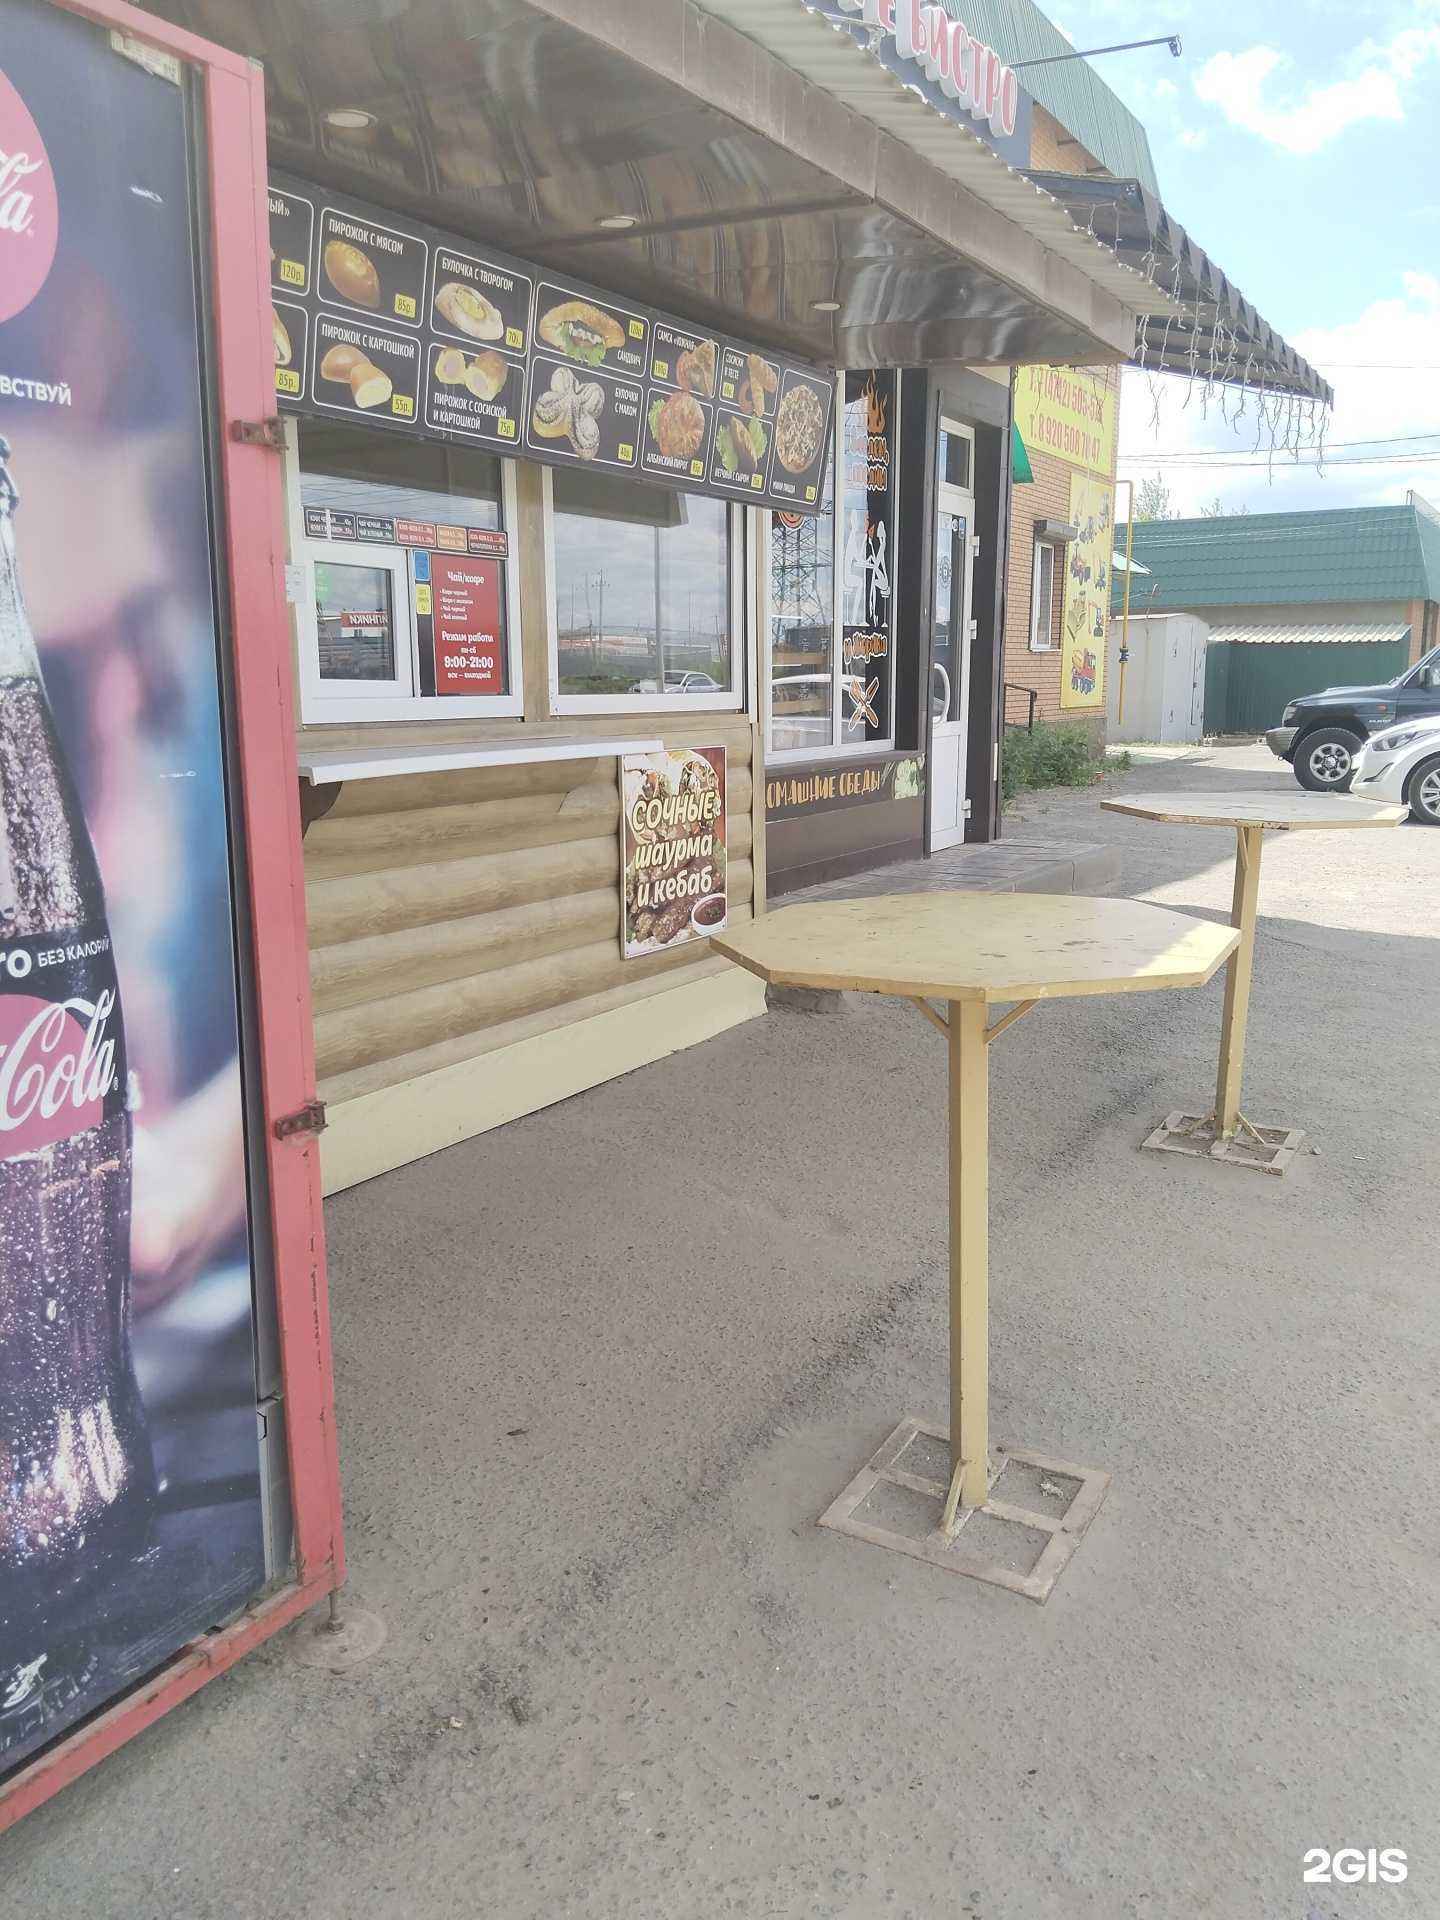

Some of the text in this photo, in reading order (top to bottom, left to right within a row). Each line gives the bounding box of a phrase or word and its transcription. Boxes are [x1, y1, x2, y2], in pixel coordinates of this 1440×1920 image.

[329, 218, 404, 255] ПИРОЖОК С МЯСОМ
[442, 258, 514, 291] БУЛОЧКА С ТВОРОГОМ
[321, 323, 415, 358] ПИРОЖОК С КАРТОШКОЙ
[657, 329, 673, 345] САМСА
[433, 411, 481, 430] И КАРТОШКОЙ
[434, 392, 468, 410] ПИРОЖОК
[474, 401, 507, 419] СОСИСКОЙ
[441, 630, 495, 645] Режим работы
[444, 656, 494, 669] 9:00-21:00
[764, 769, 881, 809] ОМАШНИЕ ОБЕДЫ
[632, 789, 715, 831] СОЧНЫЕ
[635, 834, 713, 871] шаурма
[637, 866, 713, 908] и кебаб
[38, 948, 66, 968] БЕЗ
